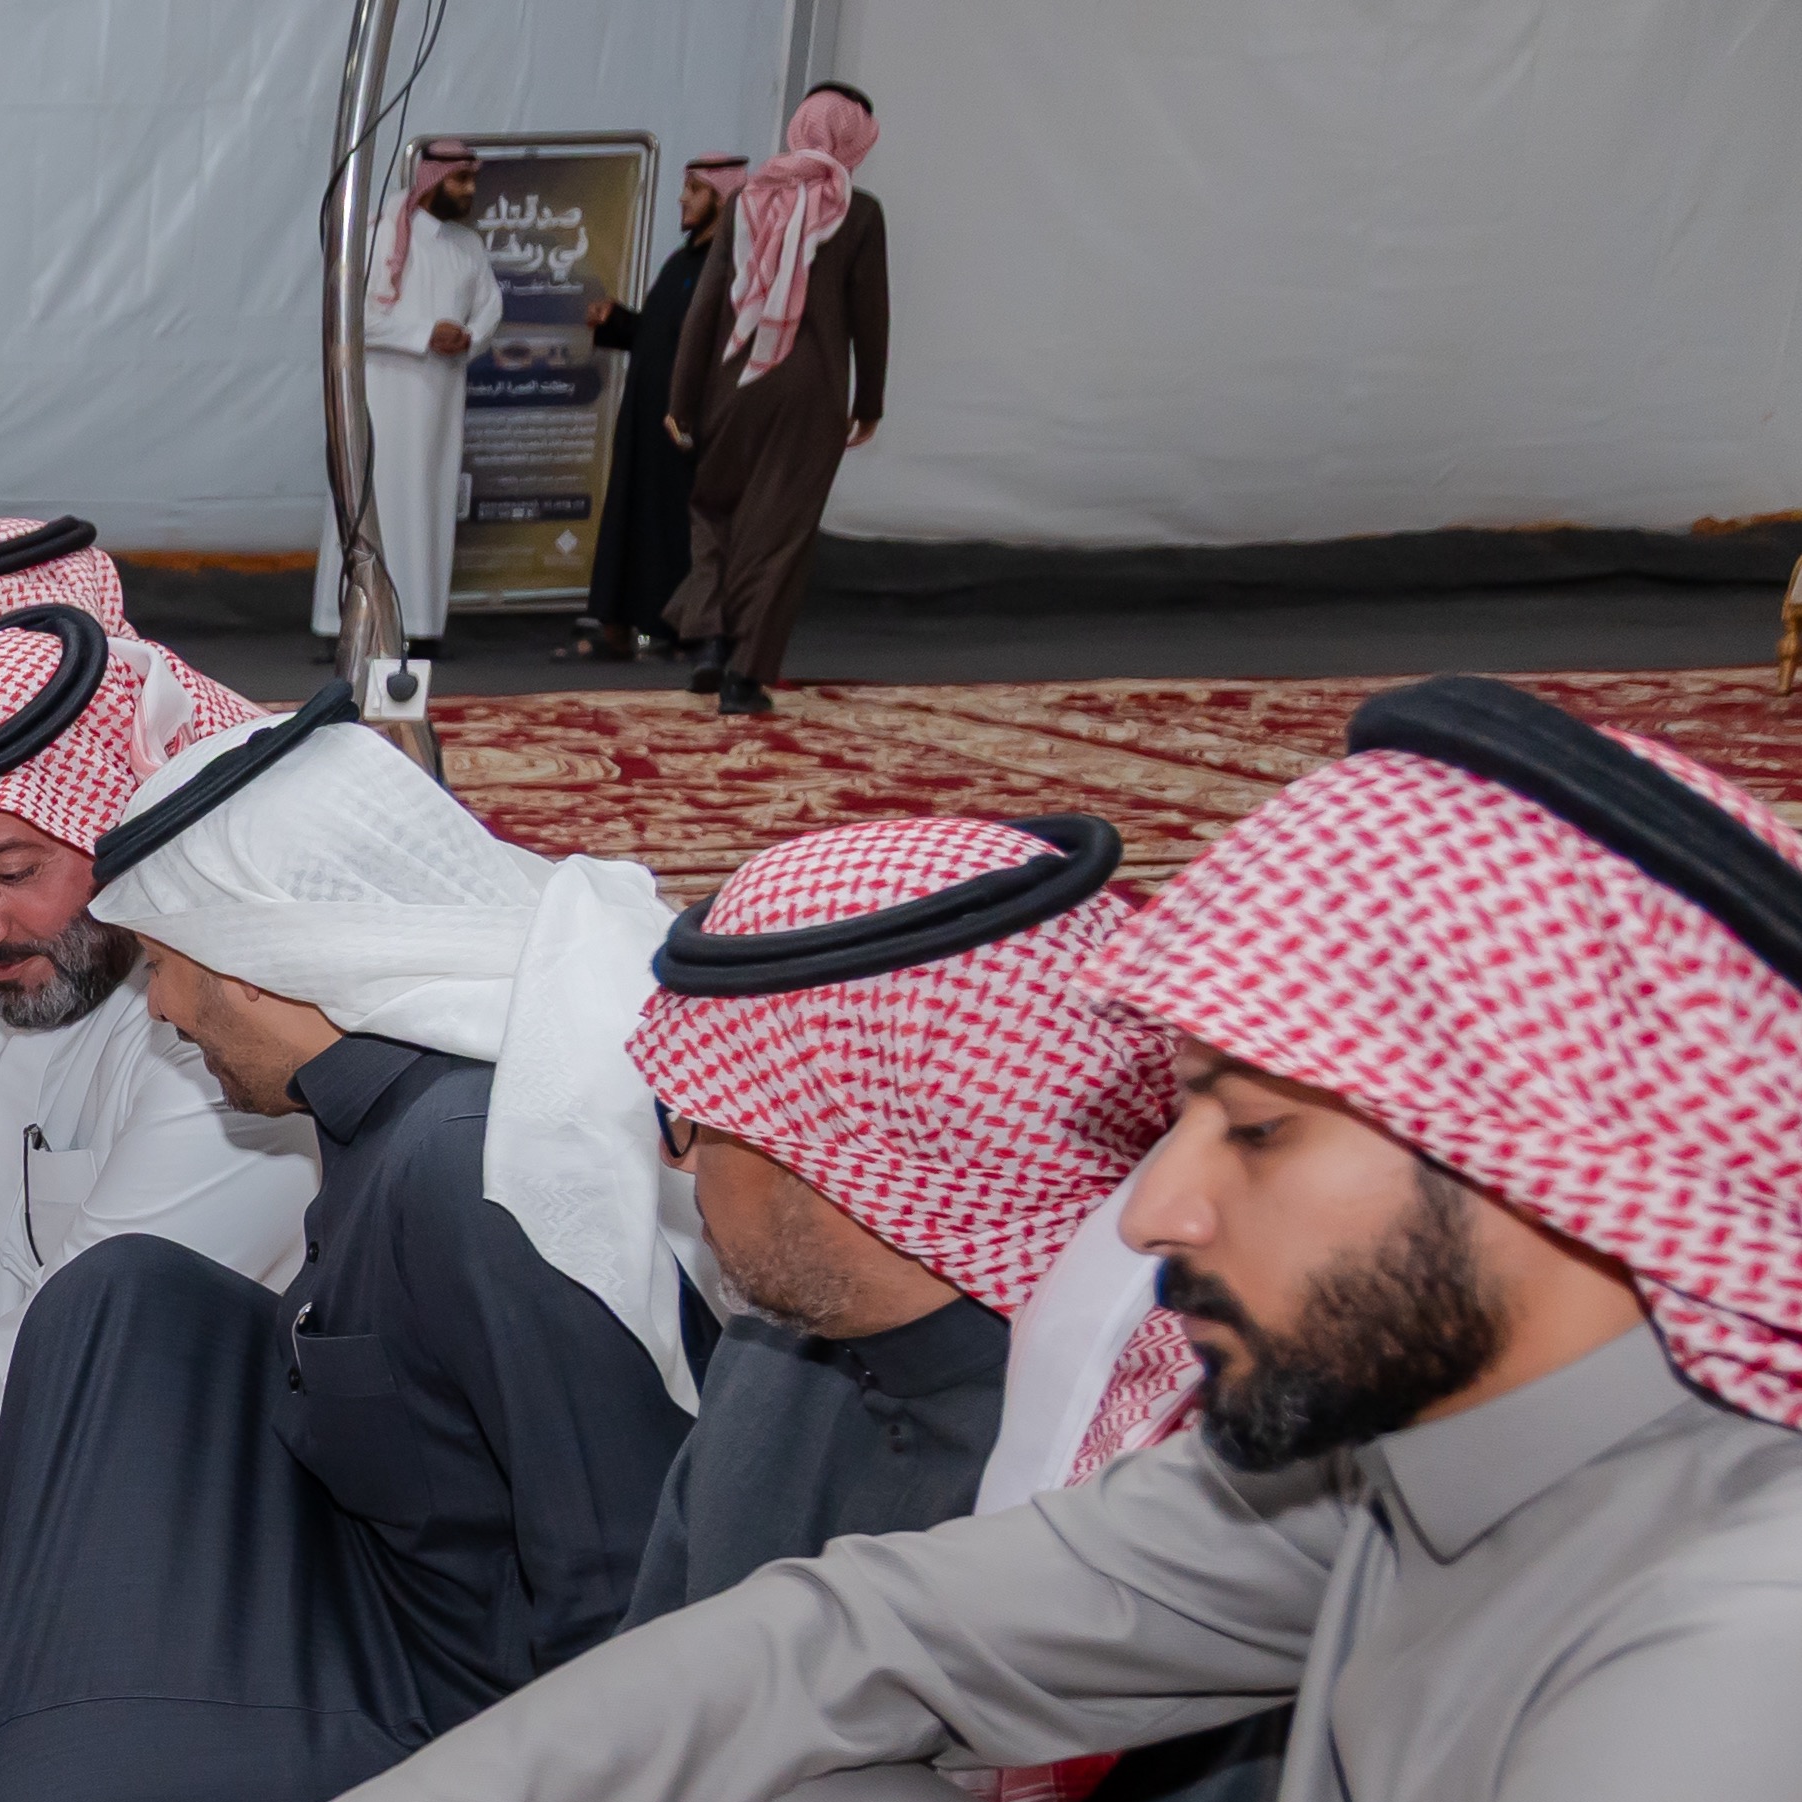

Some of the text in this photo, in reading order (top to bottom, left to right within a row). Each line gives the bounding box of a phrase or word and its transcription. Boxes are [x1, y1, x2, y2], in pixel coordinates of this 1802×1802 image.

[477, 194, 582, 230] صدقتك
[486, 226, 589, 281] في رمضا
